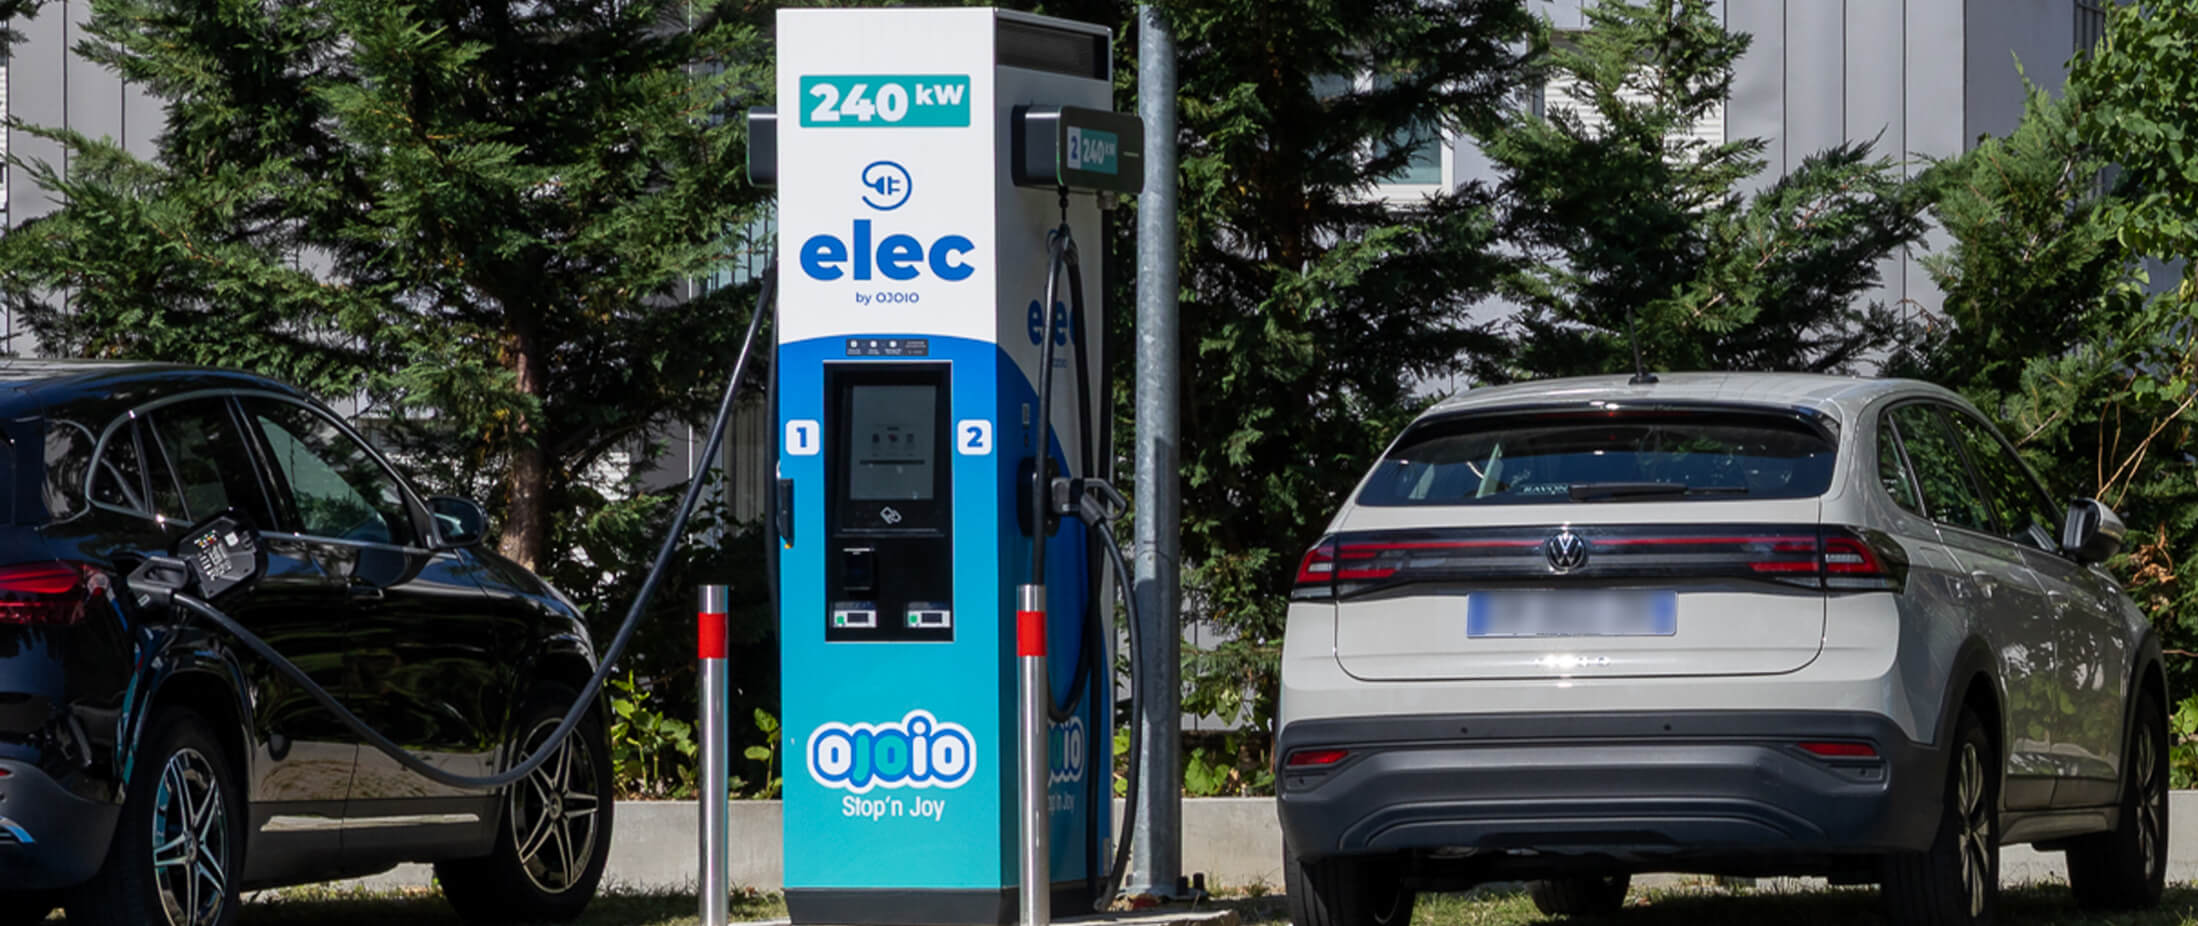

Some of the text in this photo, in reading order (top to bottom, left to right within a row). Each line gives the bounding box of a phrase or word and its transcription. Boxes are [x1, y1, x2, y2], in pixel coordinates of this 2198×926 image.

[809, 82, 965, 122] 240 kW
[1071, 135, 1079, 160] 2
[1083, 138, 1105, 165] 240
[799, 219, 975, 282] elec
[855, 292, 920, 306] by OJOIO
[796, 426, 808, 448] 1
[966, 426, 984, 448] 2
[842, 796, 945, 822] Stop'n Joy
